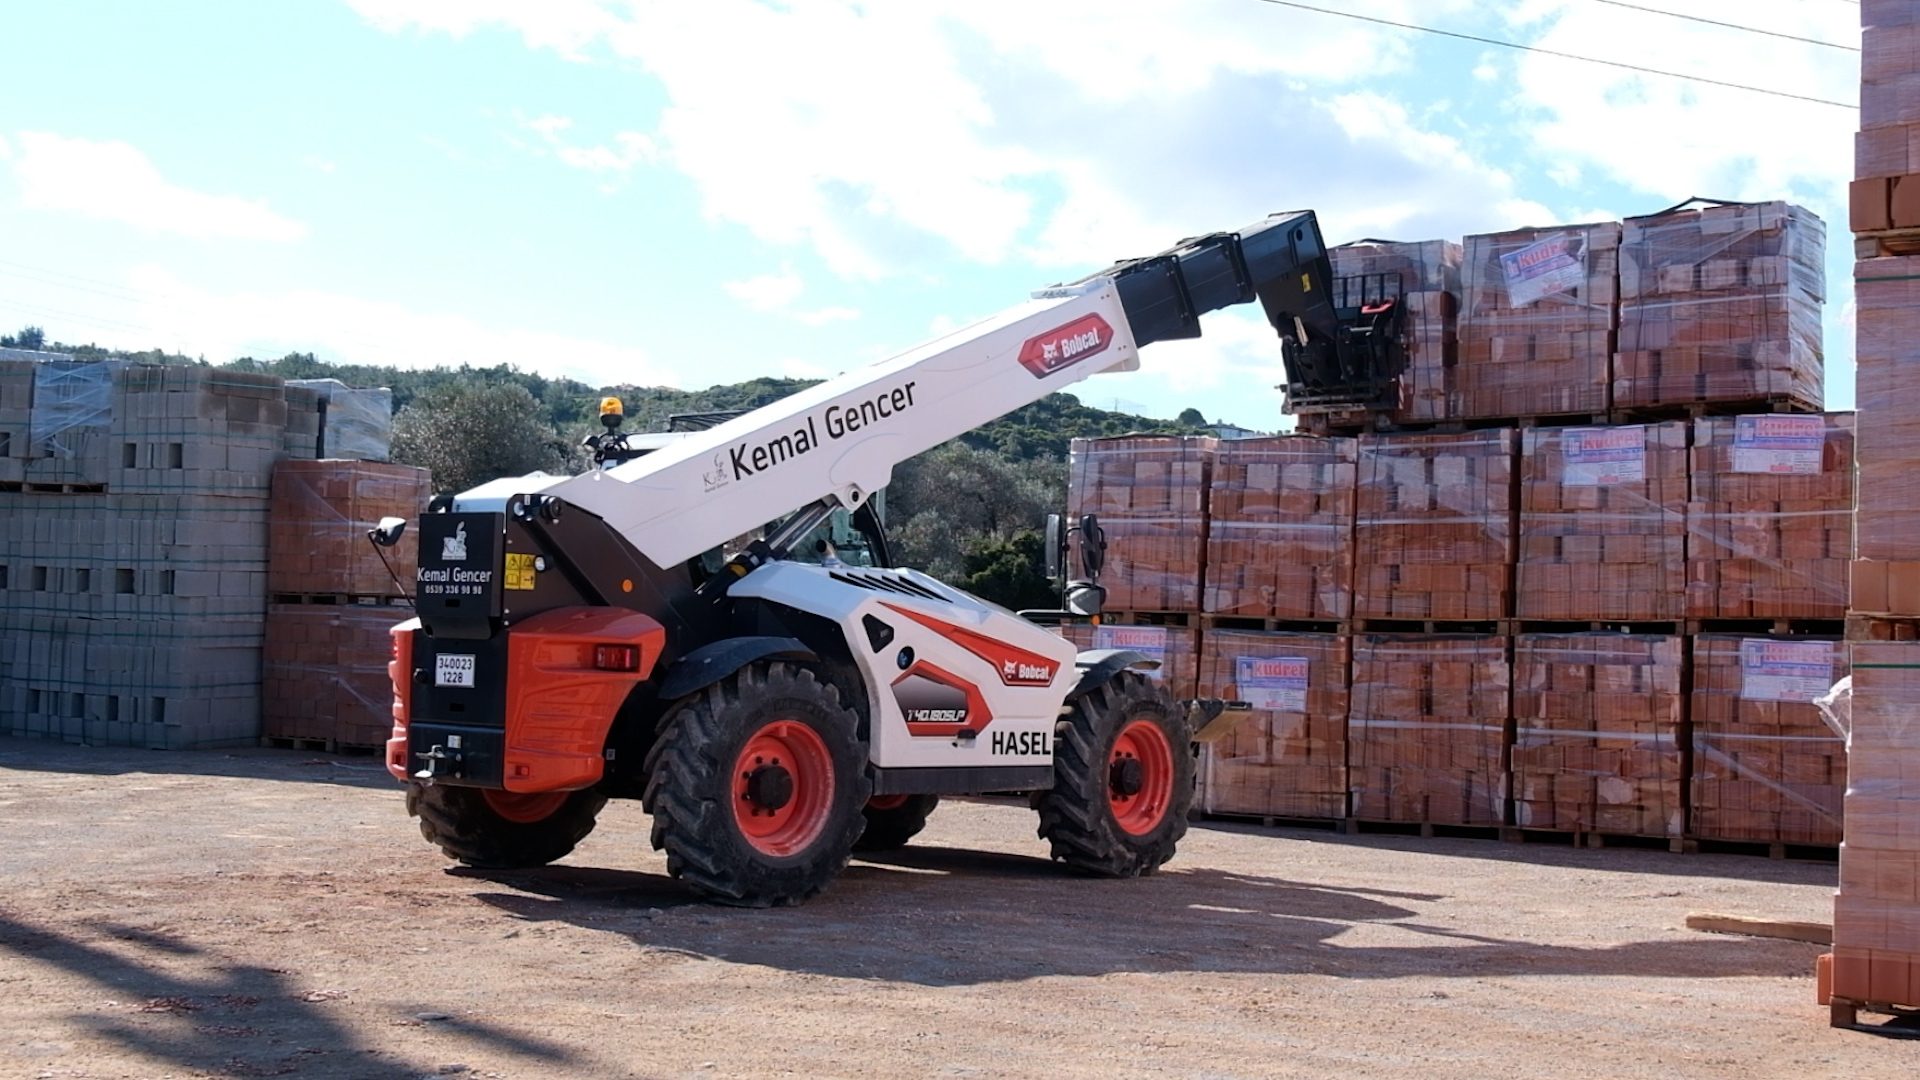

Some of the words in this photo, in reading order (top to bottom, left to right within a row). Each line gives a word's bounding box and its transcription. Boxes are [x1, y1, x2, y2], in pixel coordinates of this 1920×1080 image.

[1060, 326, 1101, 358] Bobcat
[729, 416, 819, 481] Kemal
[824, 380, 916, 440] Gencer
[417, 567, 450, 582] Kemal
[453, 567, 492, 582] Gencer
[425, 584, 443, 594] 0539
[445, 584, 459, 594] 336
[439, 657, 472, 670] 340023
[1018, 663, 1049, 680] Bobcat
[443, 671, 463, 683] 1228
[992, 731, 1051, 756] HASEL
